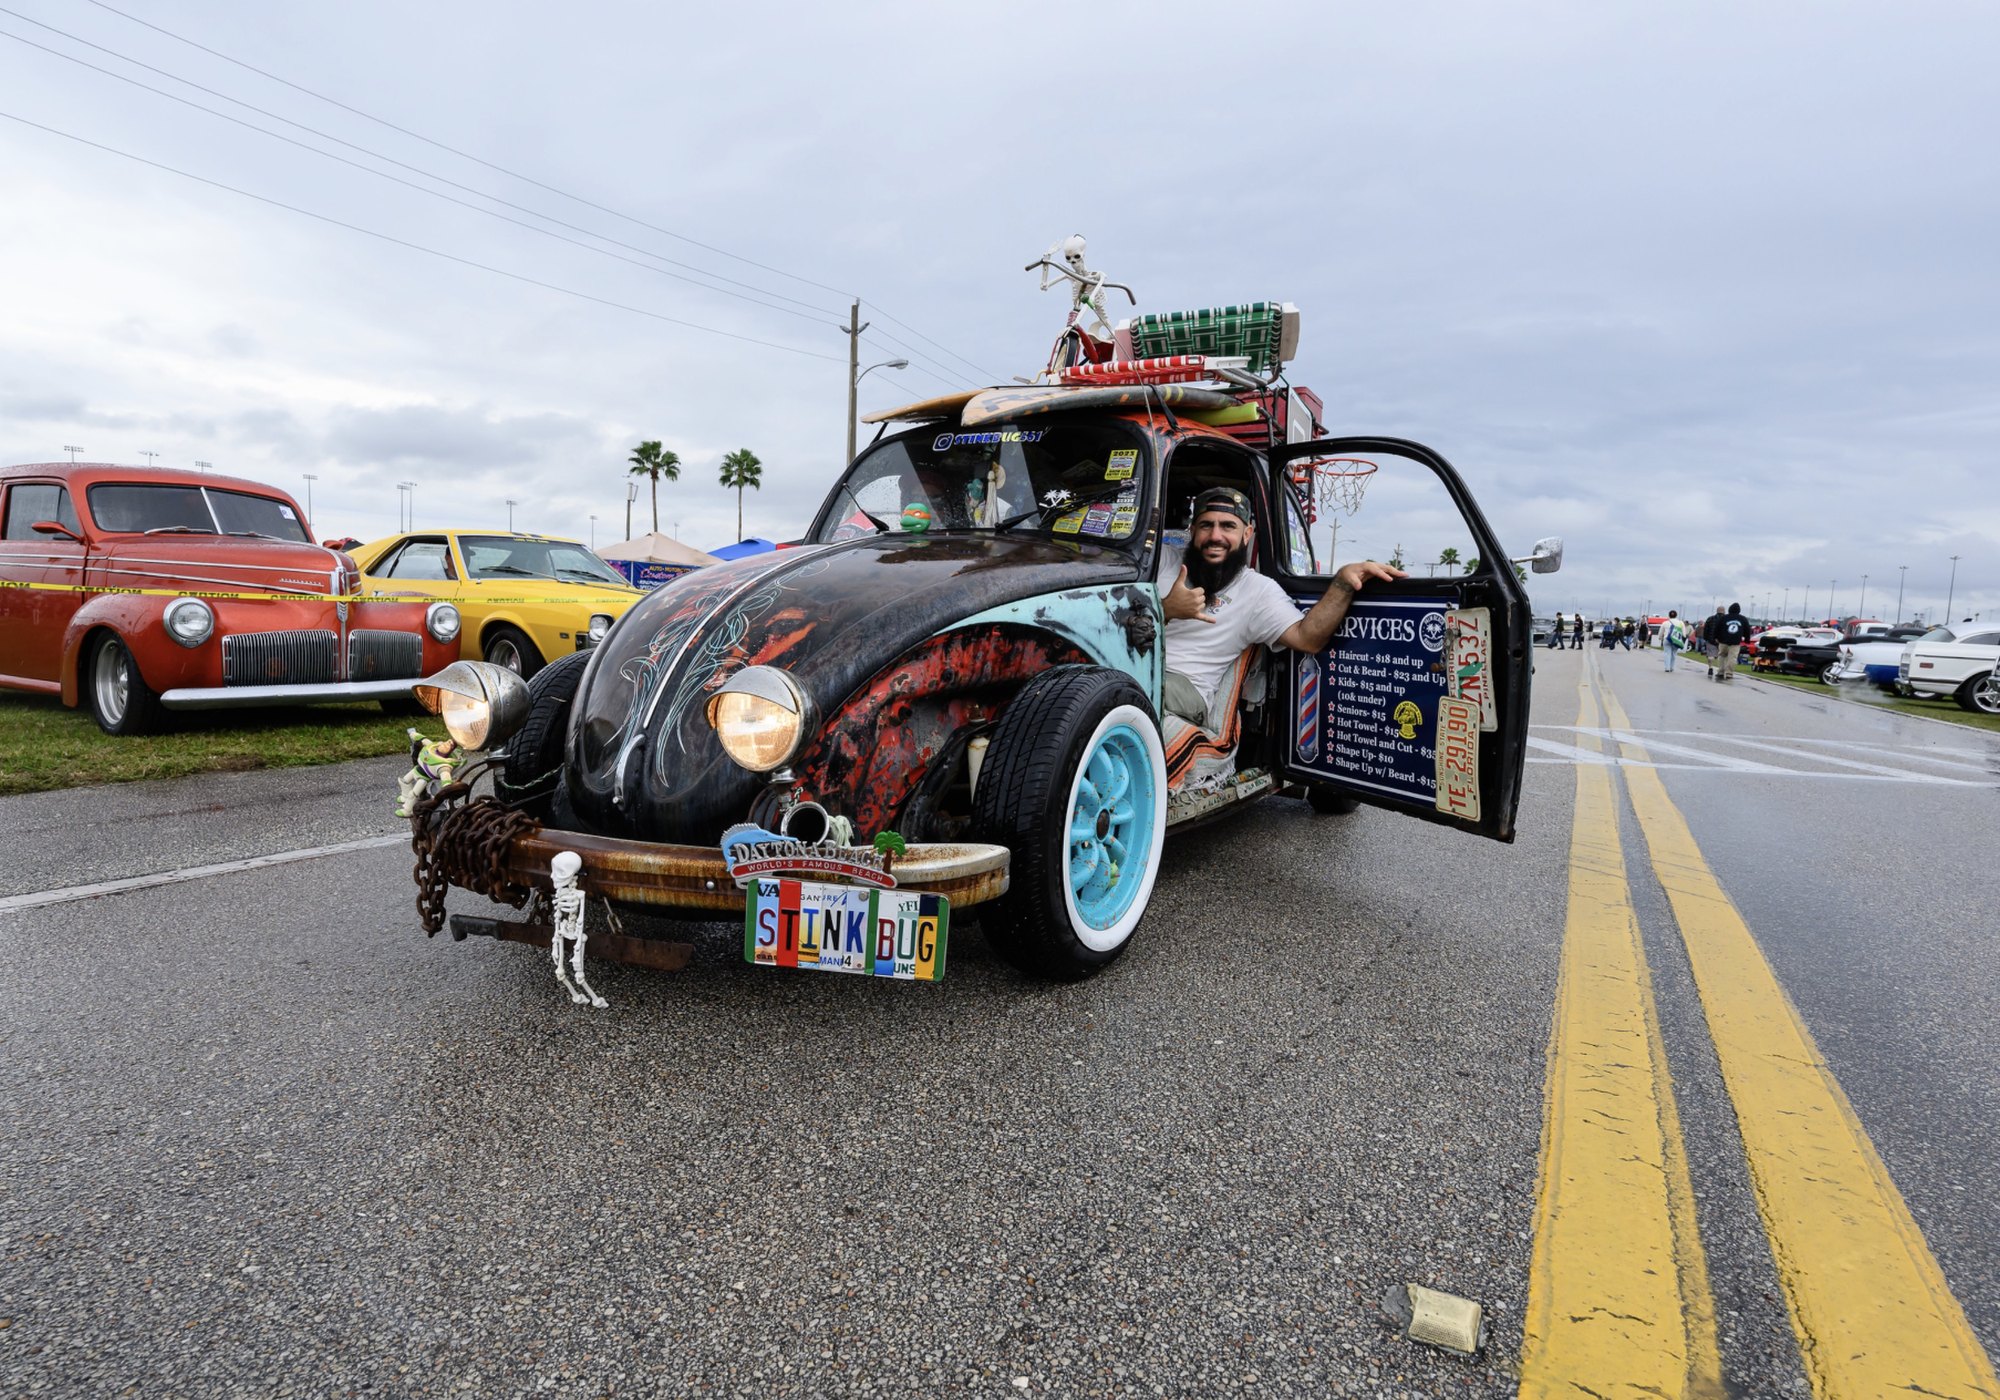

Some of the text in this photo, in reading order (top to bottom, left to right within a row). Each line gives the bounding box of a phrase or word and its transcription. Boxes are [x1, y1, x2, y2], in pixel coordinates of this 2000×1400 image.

[1334, 616, 1415, 642] RVICES
[1338, 650, 1369, 661] Haircut
[1376, 653, 1390, 664] $18
[1393, 655, 1409, 666] and
[1411, 659, 1424, 668] up
[1481, 639, 1490, 700] PINELLAS
[1338, 663, 1351, 674] Cut
[1353, 666, 1360, 675] &
[1362, 666, 1386, 678] Beard
[1394, 670, 1410, 682] $23
[1412, 672, 1429, 683] and
[1432, 674, 1446, 686] Up
[1338, 677, 1405, 696] Kids- $15 and up
[1337, 690, 1386, 707] (10& under)
[1337, 704, 1370, 717] Seniors-
[1371, 709, 1386, 721] $15
[1337, 717, 1352, 729] Hot
[1353, 720, 1377, 733] Towel
[1384, 726, 1399, 738] $15
[1336, 744, 1394, 764] Shape Up- $10
[1337, 730, 1352, 742] Hot
[1352, 733, 1377, 747] Towel
[1379, 740, 1395, 750] and
[1397, 742, 1413, 754] Cut
[1420, 747, 1437, 760] $35
[1335, 757, 1360, 771] Shape
[1361, 762, 1374, 775] Up
[1375, 766, 1387, 778] w/
[1388, 769, 1415, 783] Beard
[1467, 731, 1475, 794] FLORIDA
[733, 840, 884, 872] DAYTONA BEACH
[747, 860, 883, 882] WORLD'S FAMOUS BEACH
[758, 908, 934, 963] STINK BUG
